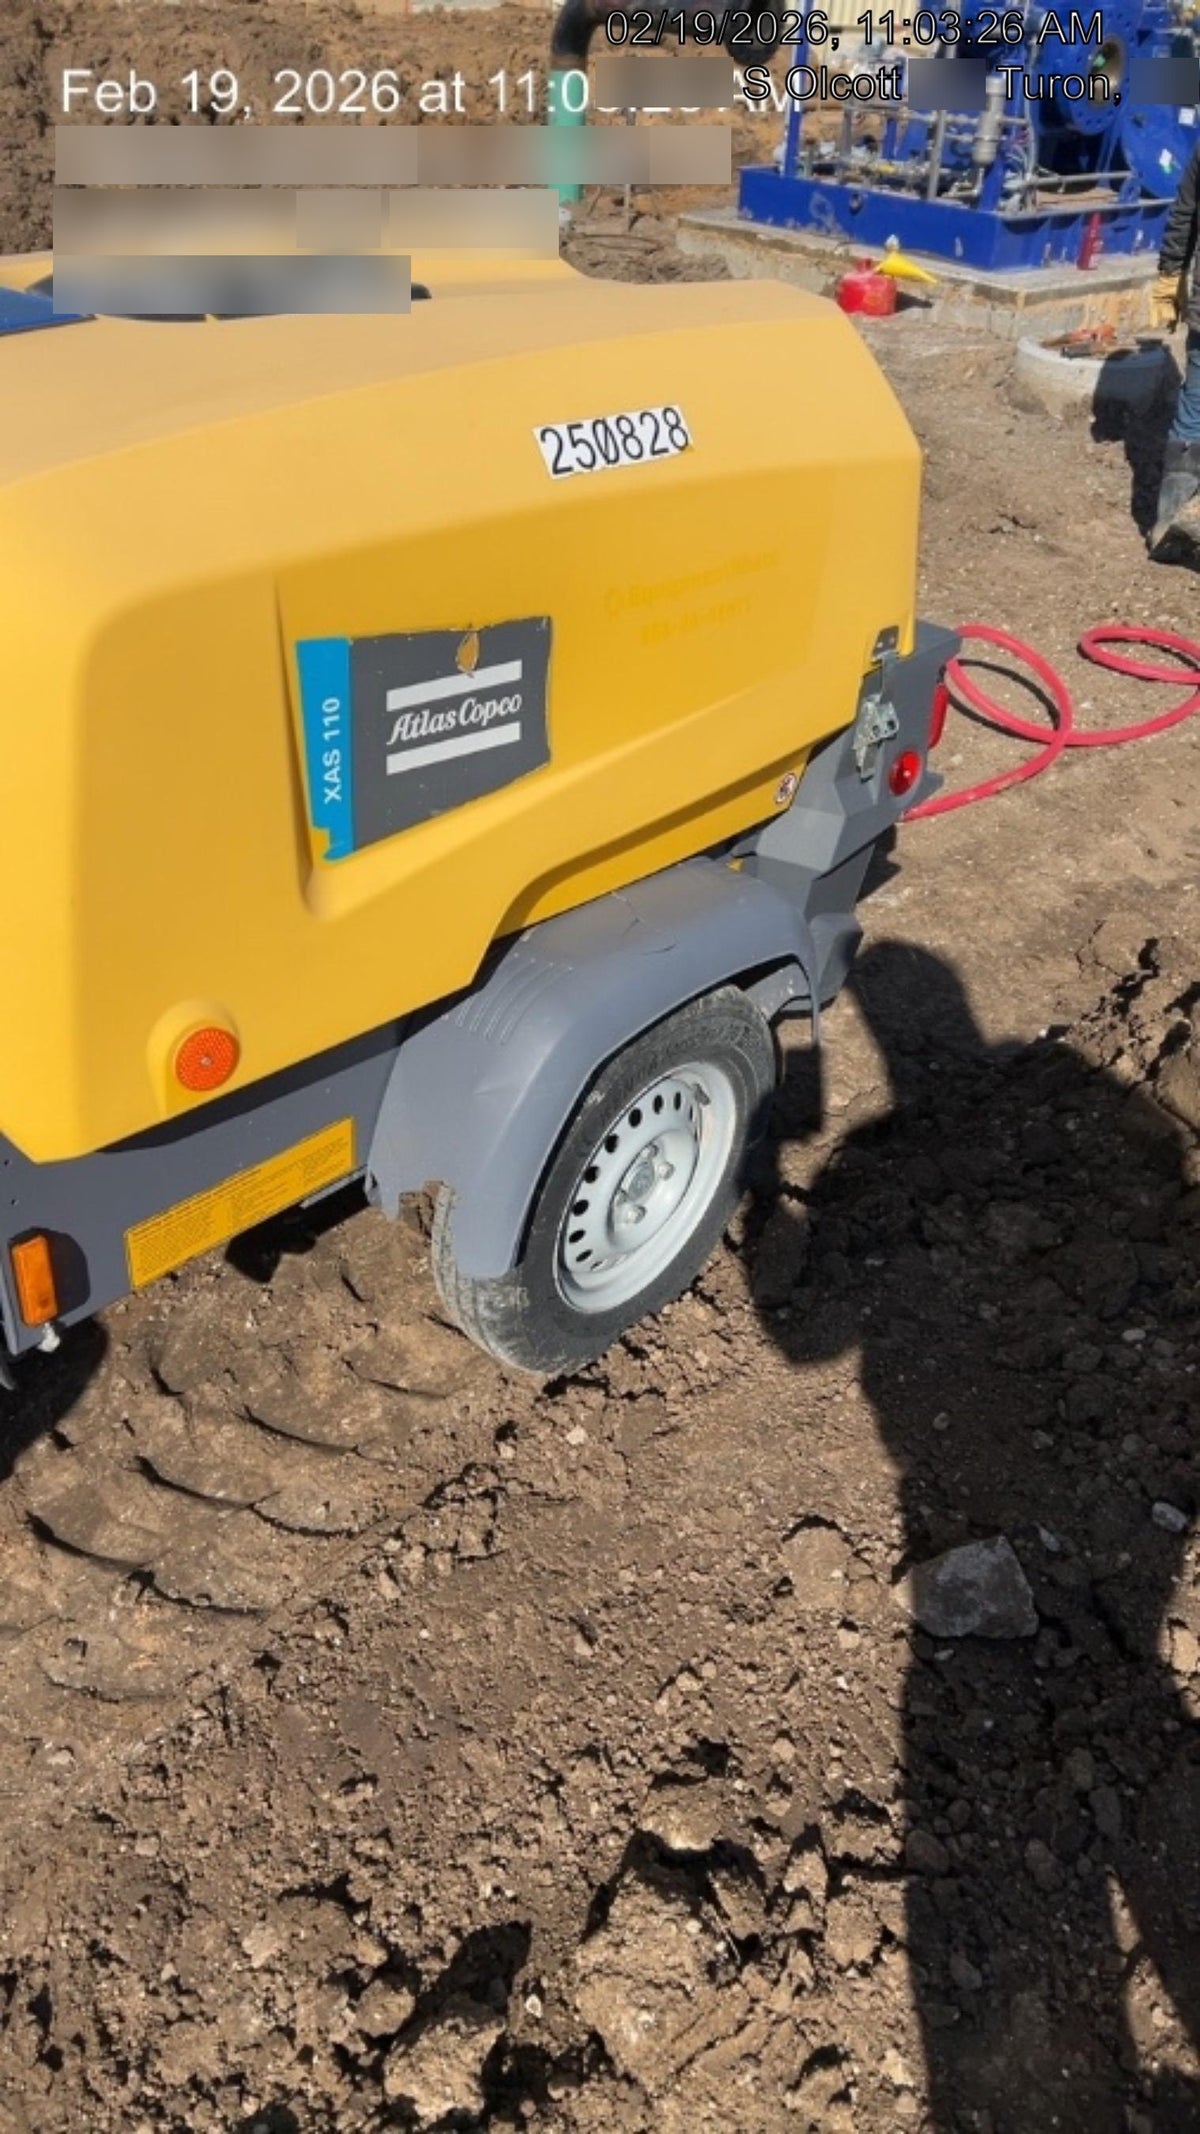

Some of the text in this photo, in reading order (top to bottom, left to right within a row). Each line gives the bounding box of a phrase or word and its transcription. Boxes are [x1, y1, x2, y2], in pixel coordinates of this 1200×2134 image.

[540, 407, 689, 475] 250828
[322, 697, 343, 805] XAS 110
[386, 694, 523, 745] Atlas Copco
